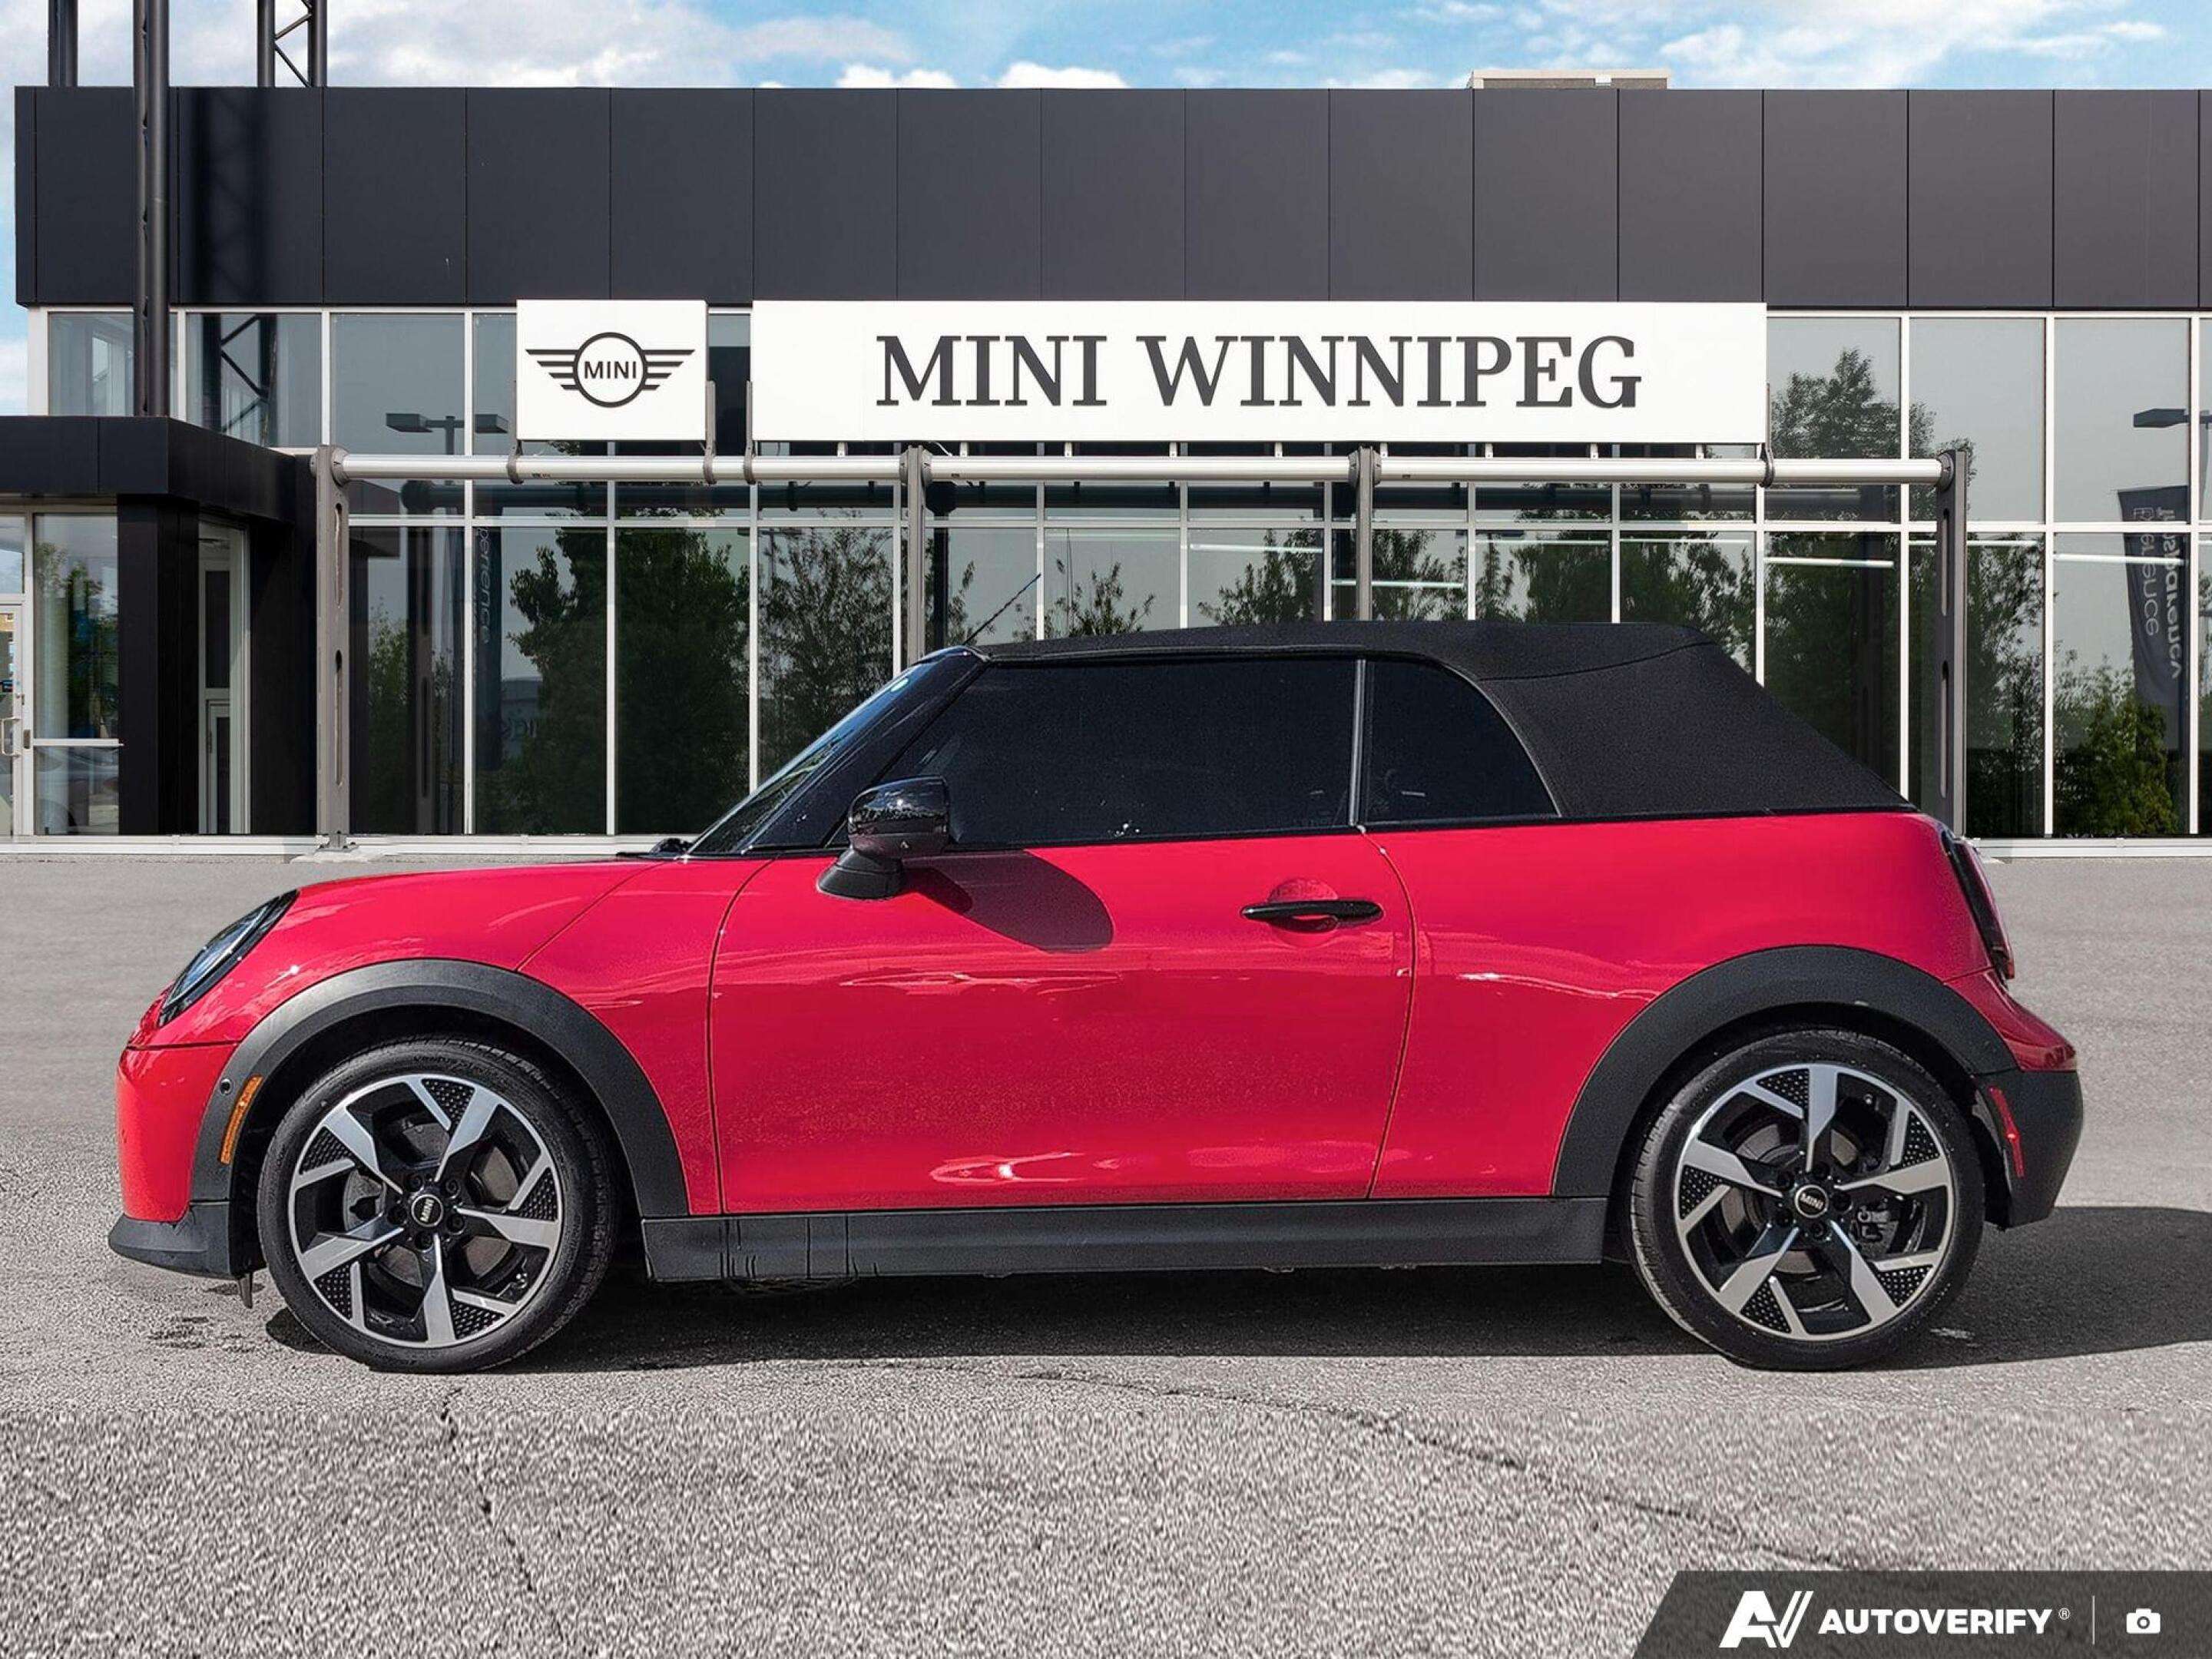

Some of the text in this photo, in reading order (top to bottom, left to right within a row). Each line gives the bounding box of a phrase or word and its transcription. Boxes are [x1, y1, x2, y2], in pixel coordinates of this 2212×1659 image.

[583, 360, 637, 380] MINI
[877, 336, 1642, 408] MINI WINNIPEG
[419, 1198, 435, 1223] MINI
[1800, 1193, 1824, 1210] MINI
